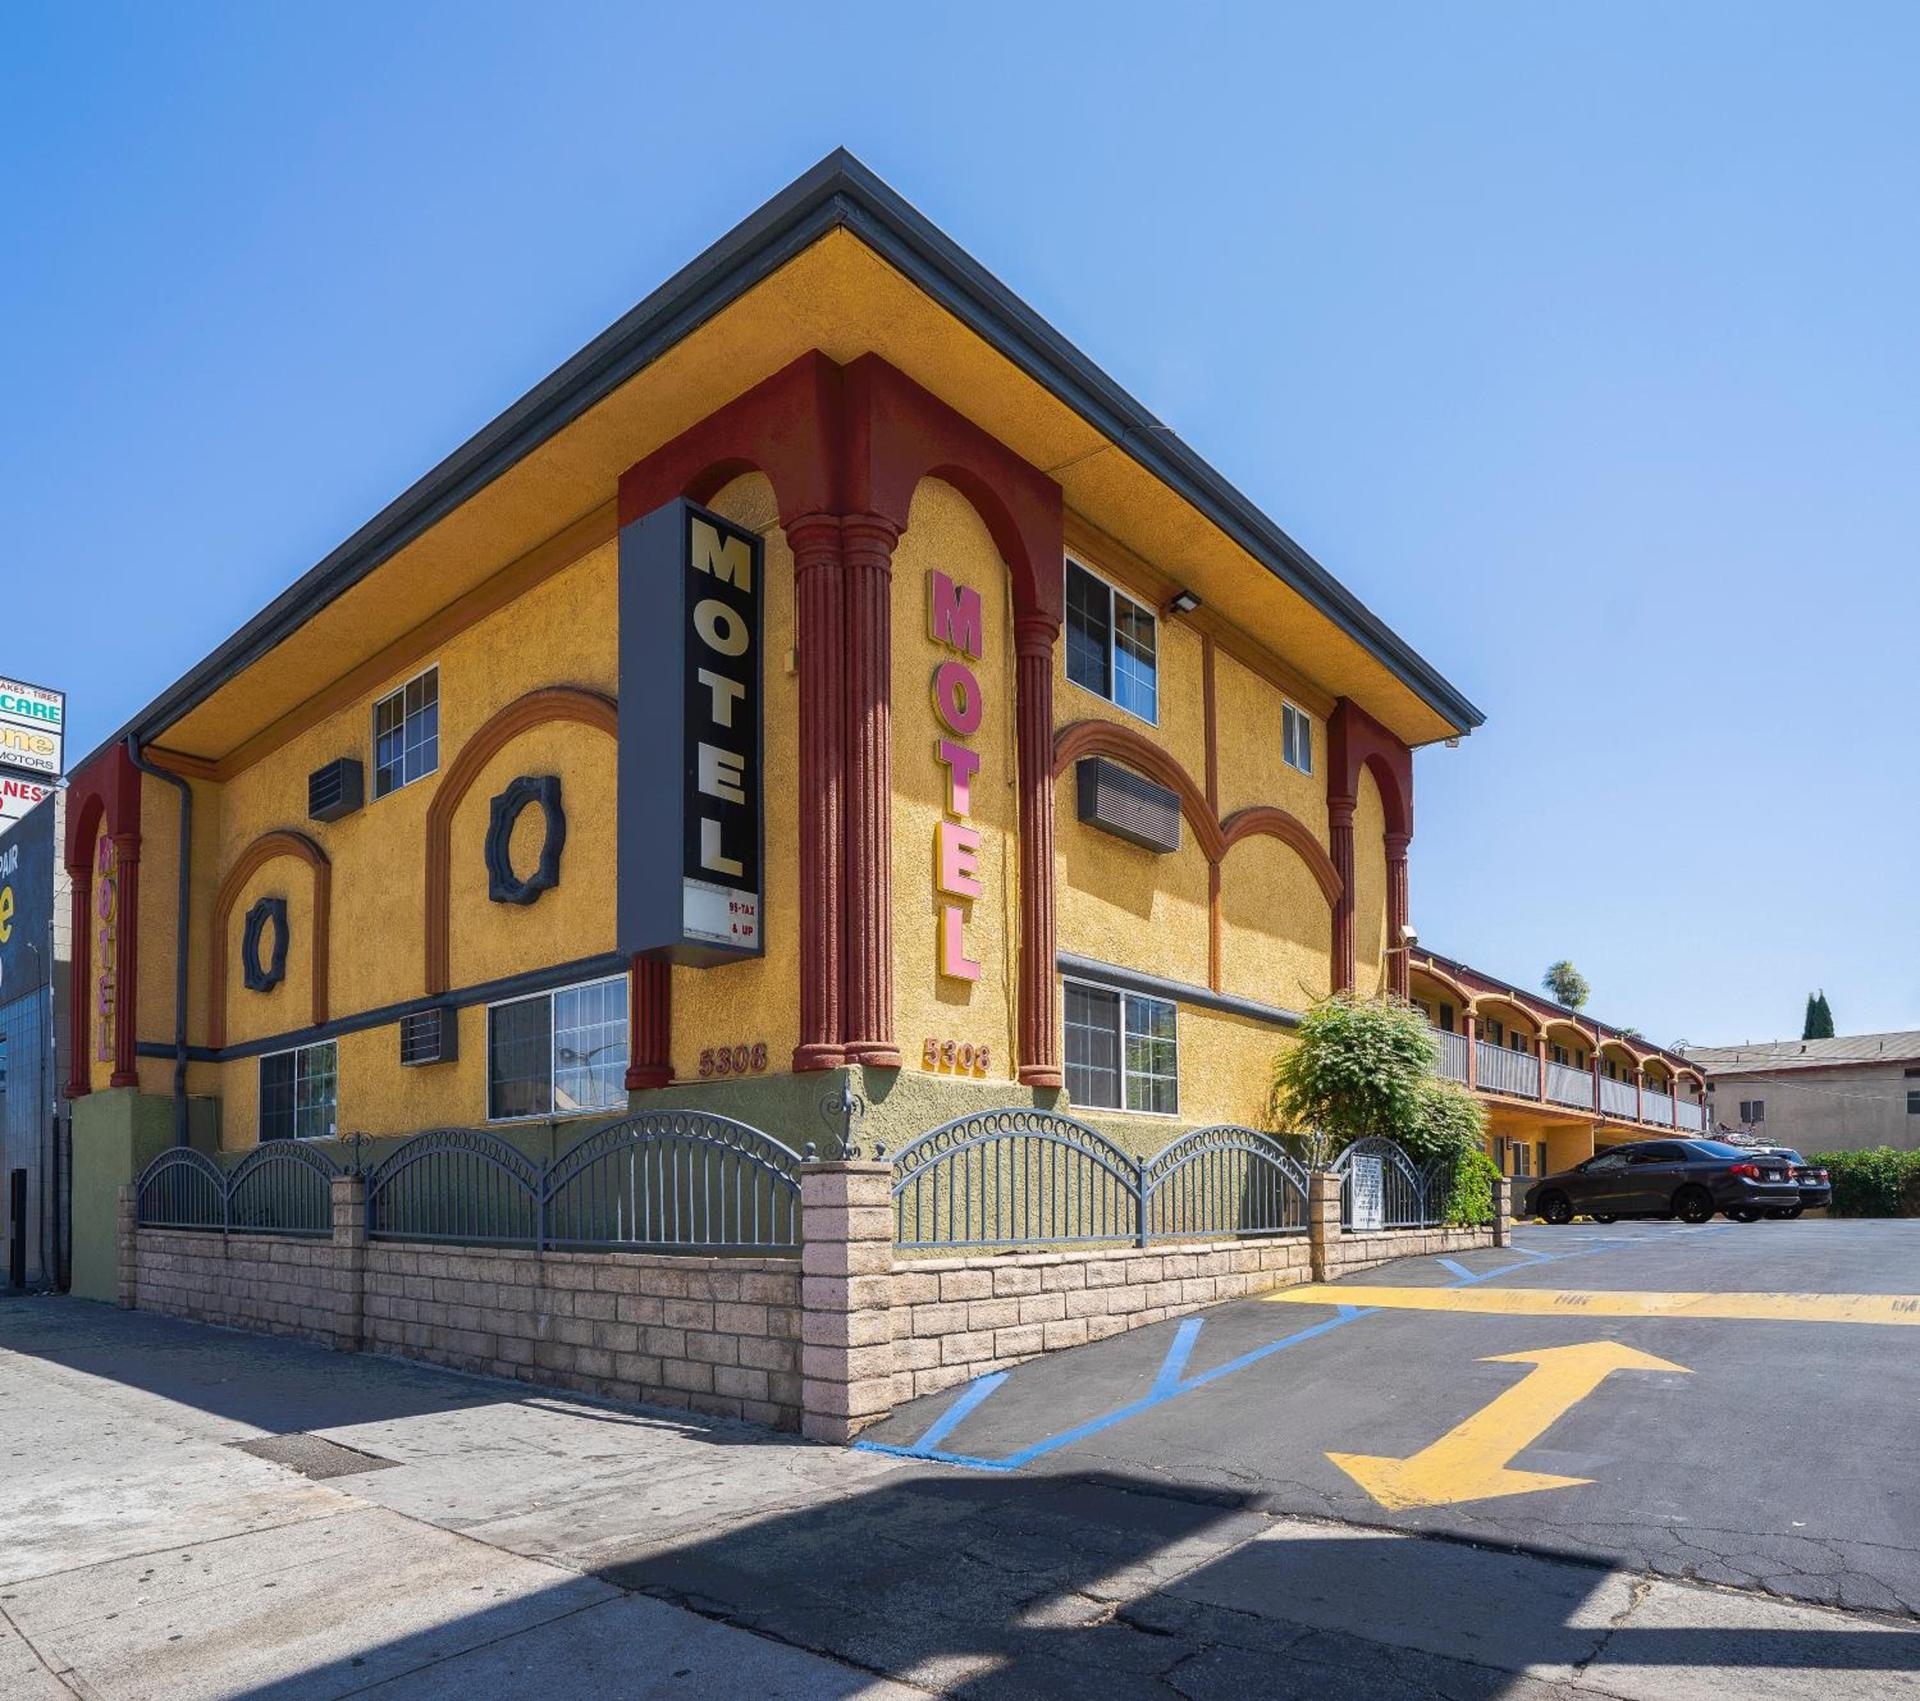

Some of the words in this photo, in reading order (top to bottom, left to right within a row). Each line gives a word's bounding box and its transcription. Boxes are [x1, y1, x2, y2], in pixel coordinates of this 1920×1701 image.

[0, 694, 60, 721] CARE
[33, 690, 58, 703] TIRES
[691, 517, 751, 877] MOTEL
[0, 727, 54, 755] ne
[927, 568, 982, 982] MOTEL
[0, 780, 42, 802] NES
[742, 925, 754, 937] UP
[699, 1042, 768, 1077] 5308
[922, 1038, 990, 1071] 5308
